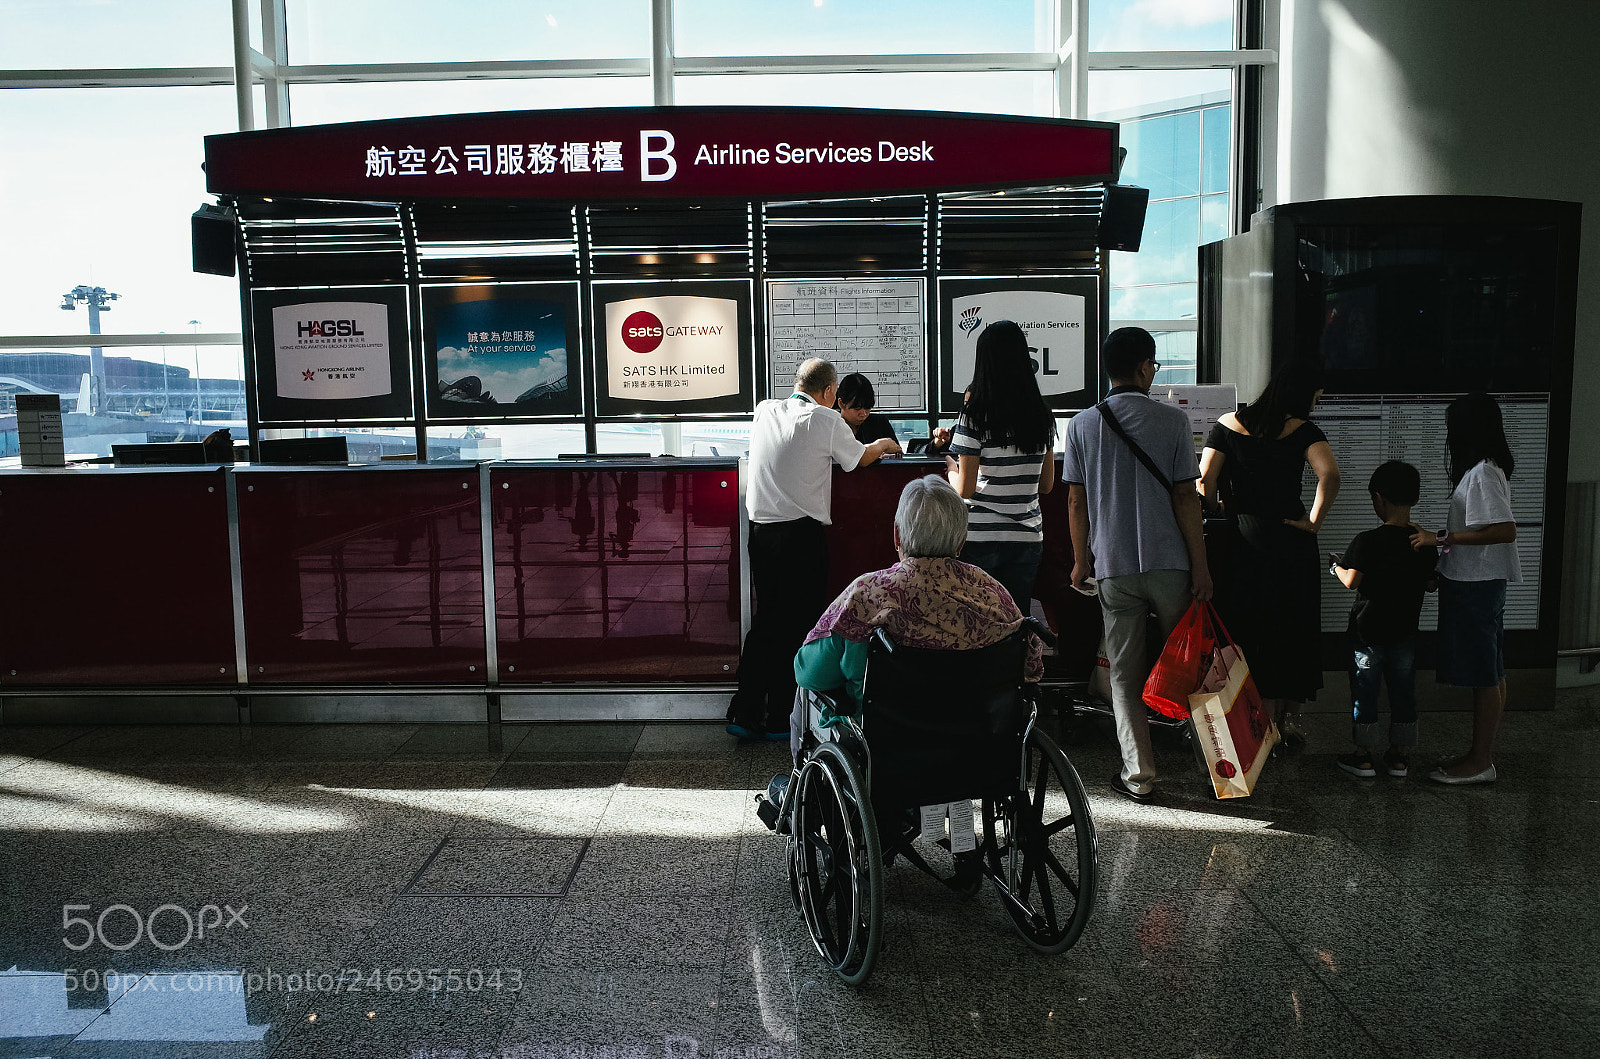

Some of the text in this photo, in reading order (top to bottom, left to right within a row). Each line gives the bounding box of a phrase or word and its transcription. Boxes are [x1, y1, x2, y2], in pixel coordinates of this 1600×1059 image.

[364, 129, 935, 183] 航空公司服務櫃臺 B Airline Services Desk
[796, 285, 896, 297] 航班資料 Flights Information
[297, 319, 365, 338] HAGSL
[1047, 320, 1080, 329] Services
[467, 330, 536, 343] 誠意為您服務
[628, 325, 724, 338] sats GATEWAY
[467, 343, 537, 356] At your service
[622, 363, 725, 377] SATS HK Limited
